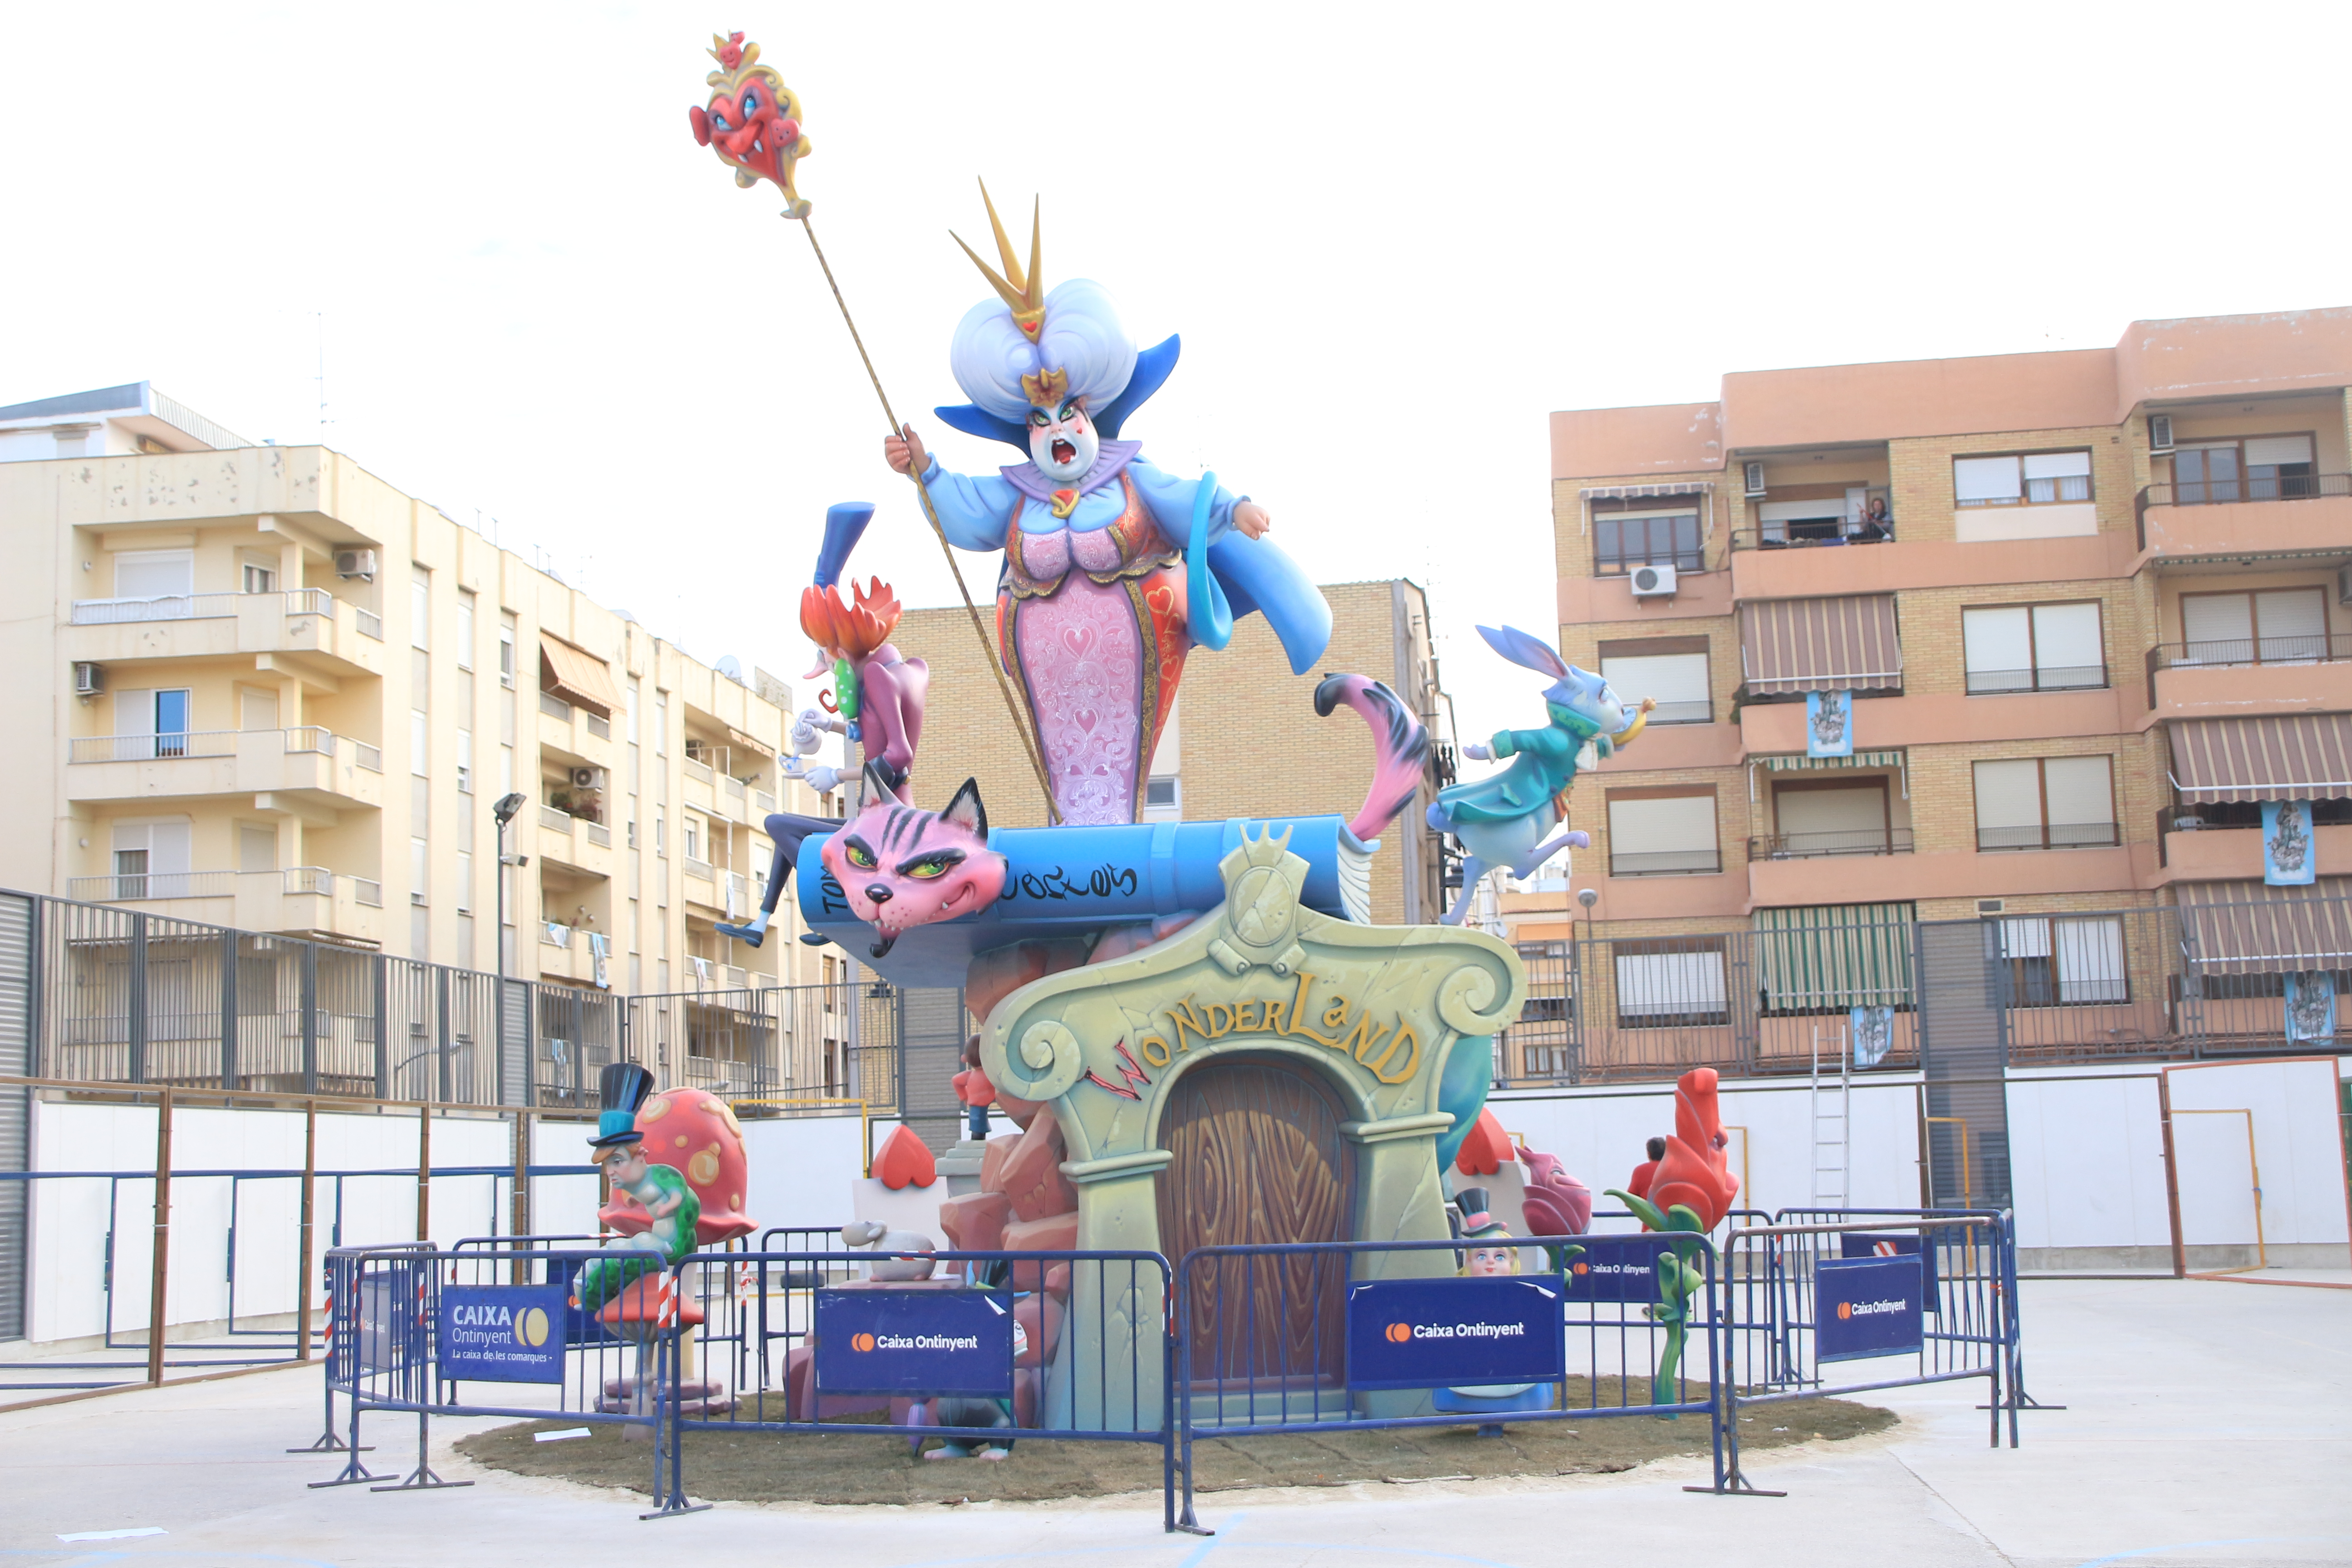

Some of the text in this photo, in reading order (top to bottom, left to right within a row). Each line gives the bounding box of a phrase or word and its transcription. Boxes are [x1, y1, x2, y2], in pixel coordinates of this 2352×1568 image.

[453, 1305, 512, 1326] CAIXA
[1852, 1298, 1906, 1315] Caixa Ontinyent
[453, 1327, 511, 1348] Ontinyent
[1413, 1321, 1524, 1339] Caixa Ontinyent
[877, 1333, 978, 1352] Caixa Ontinyent
[453, 1349, 547, 1364] La caixa de les comarques
